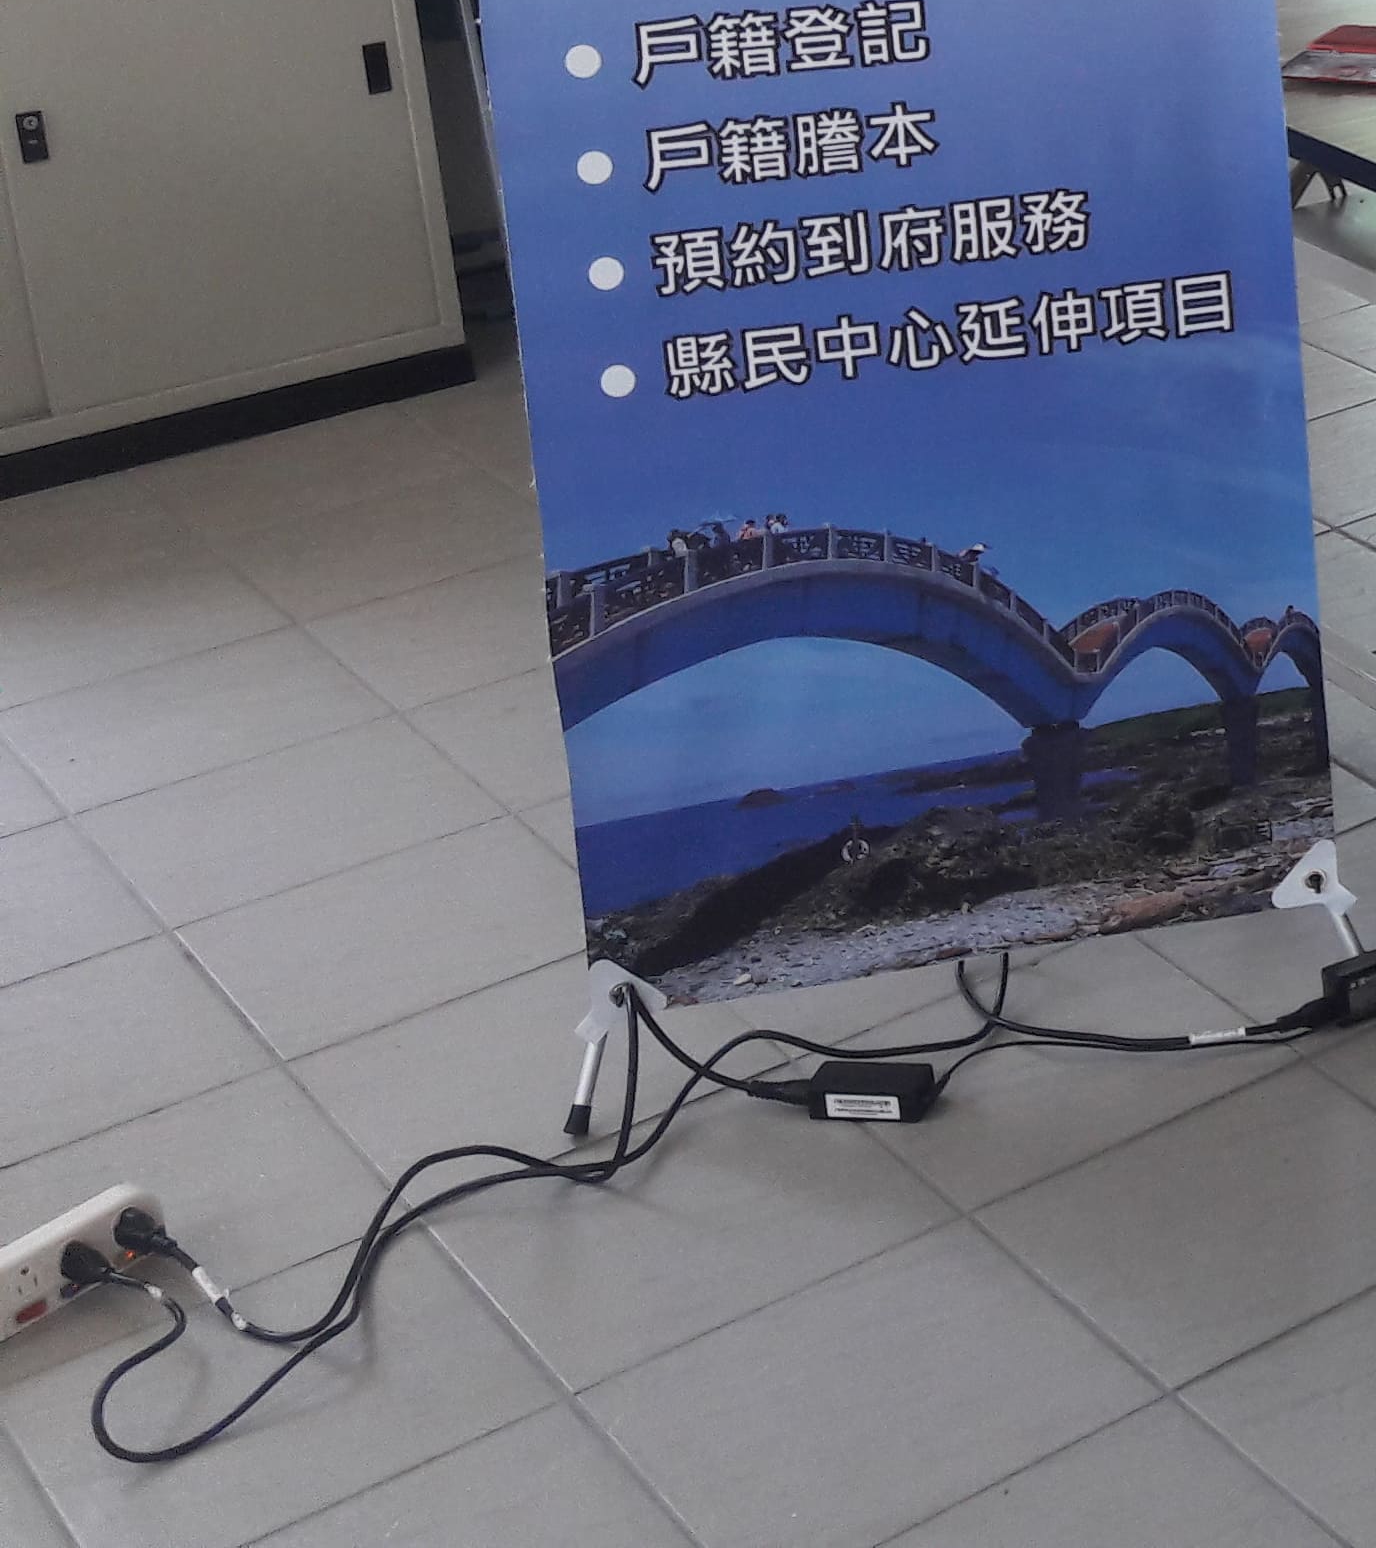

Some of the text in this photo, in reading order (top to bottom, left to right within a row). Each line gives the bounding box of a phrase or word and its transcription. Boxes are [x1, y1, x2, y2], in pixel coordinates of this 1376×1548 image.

[644, 102, 940, 194] 戶籍謄本
[651, 190, 1090, 296] 預約到府服務
[663, 270, 1235, 400] 縣民中心延伸項目
